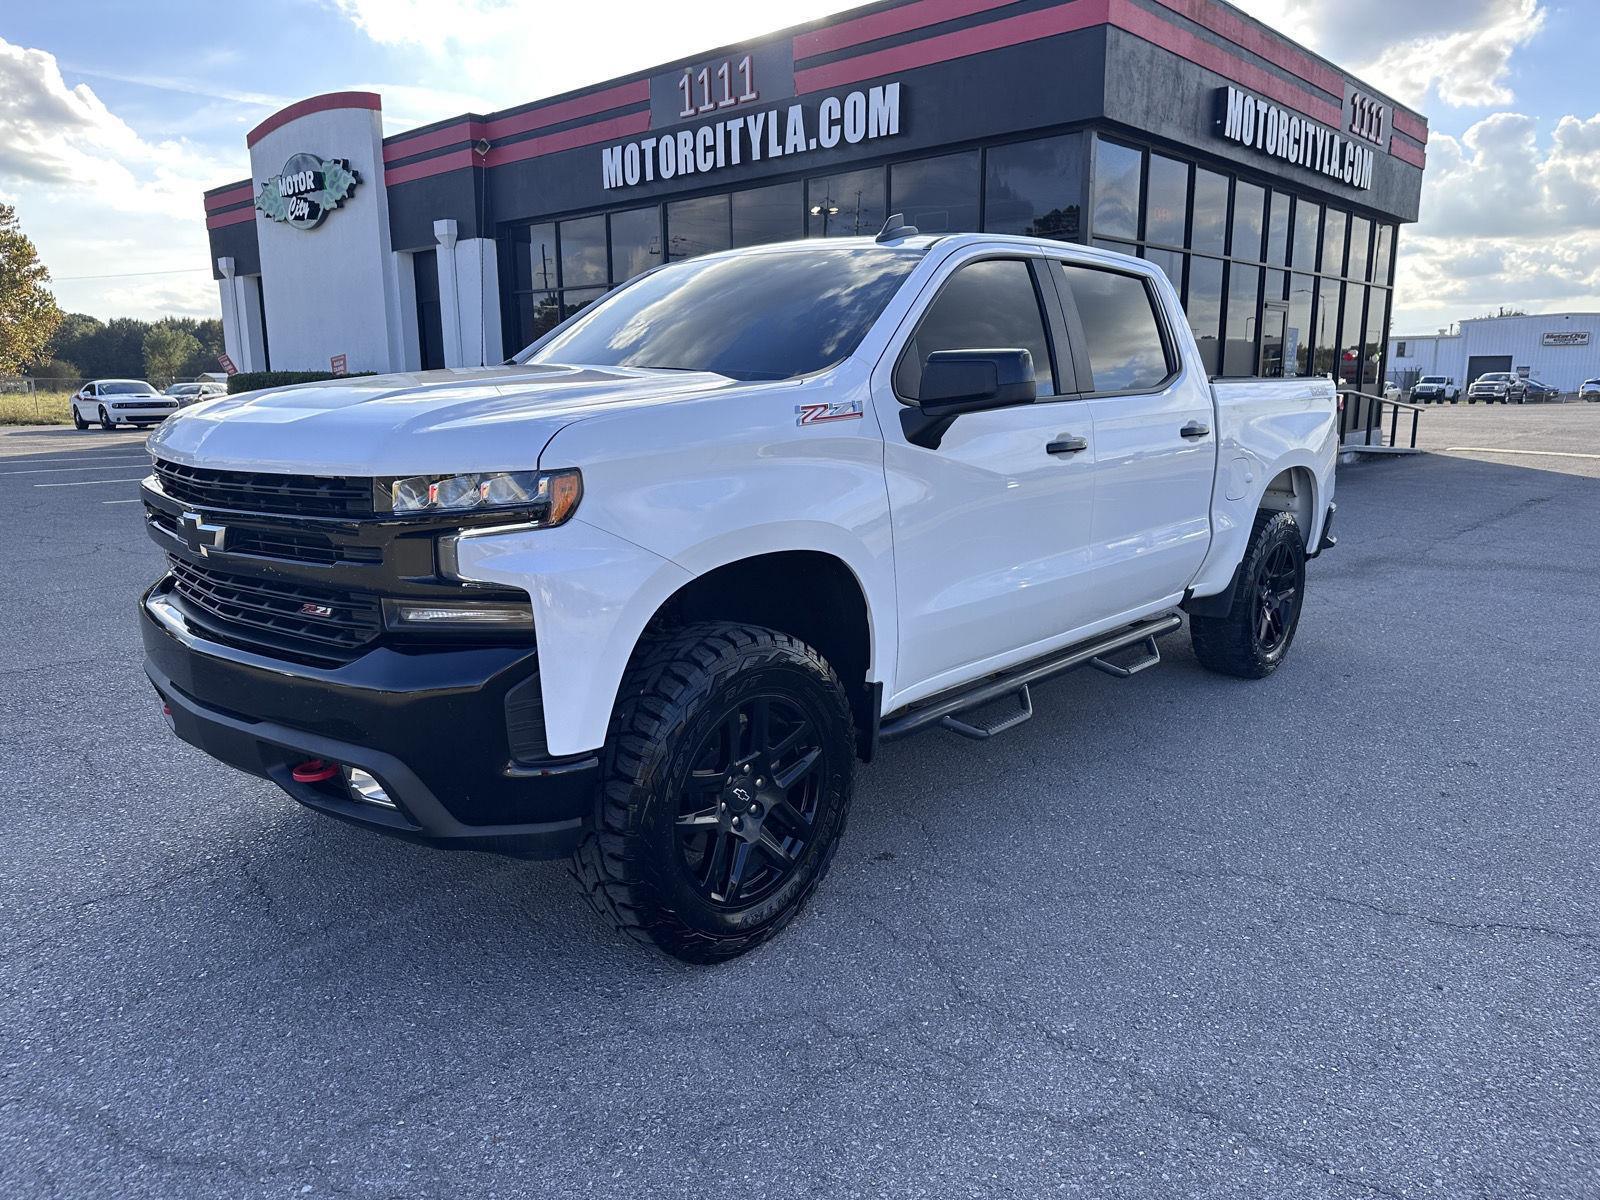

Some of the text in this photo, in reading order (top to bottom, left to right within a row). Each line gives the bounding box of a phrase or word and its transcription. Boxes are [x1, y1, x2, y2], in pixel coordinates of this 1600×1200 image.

[678, 55, 759, 117] 1111
[602, 81, 901, 190] MOTORCITYLA.COM
[1224, 86, 1374, 190] MOTORCITYLA.COM
[1350, 93, 1385, 145] 1111
[279, 170, 316, 197] MOTOR
[289, 197, 310, 220] City
[795, 400, 864, 427] Z71
[301, 603, 333, 617] Z71
